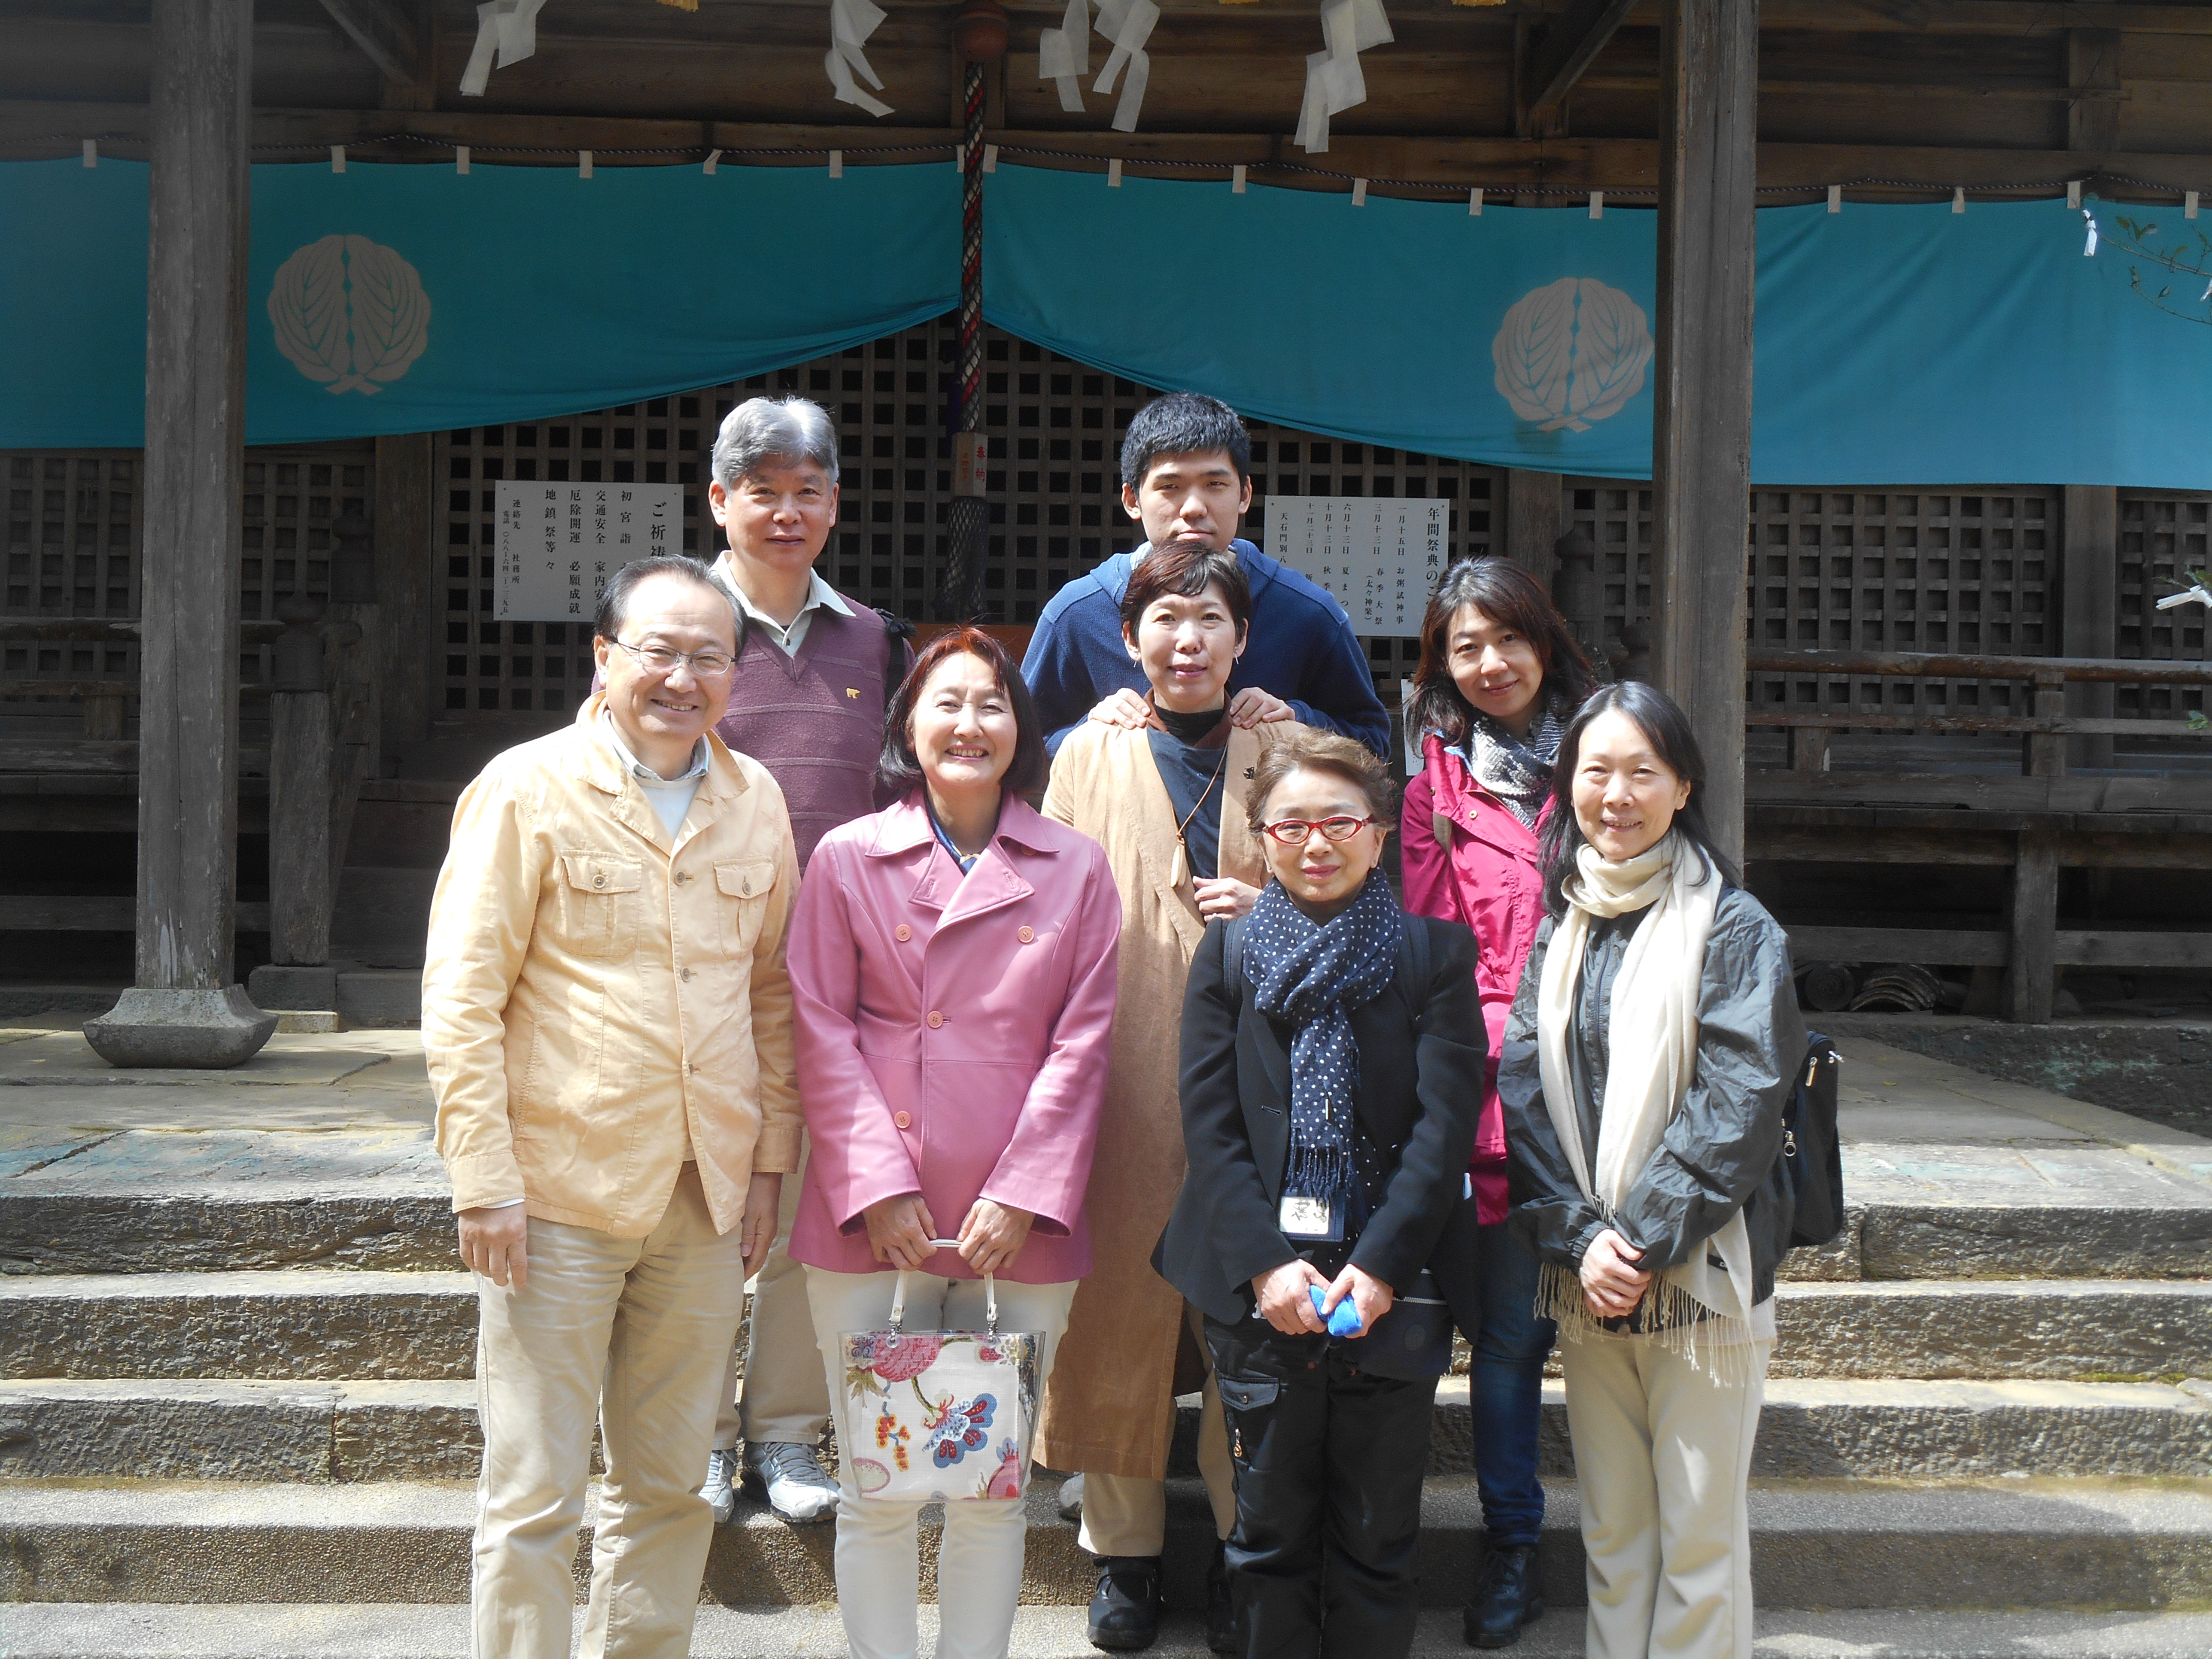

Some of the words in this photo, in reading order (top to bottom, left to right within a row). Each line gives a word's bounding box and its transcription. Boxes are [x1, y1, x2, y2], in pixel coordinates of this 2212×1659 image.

[975, 445, 986, 482] 奉納
[503, 510, 510, 524] 電話
[512, 499, 521, 529] 連絡先
[544, 489, 556, 570] 地鎮祭等々
[569, 489, 581, 543] 厄除開運
[596, 490, 606, 544] 交通安全
[620, 490, 632, 544] 初宮詣
[1306, 503, 1314, 554] 十一月二十三日
[1324, 503, 1333, 554] 十月十三日
[1342, 503, 1351, 554] 六月十三日
[1373, 503, 1382, 555] 三月十三日
[1398, 507, 1406, 556] 一月十五日
[512, 554, 520, 584] 社務所
[1426, 507, 1440, 605] 年間祭典のこ
[569, 561, 580, 614] 必願成就
[1375, 568, 1384, 625] 春季大祭
[1396, 567, 1405, 624] お粥試神事
